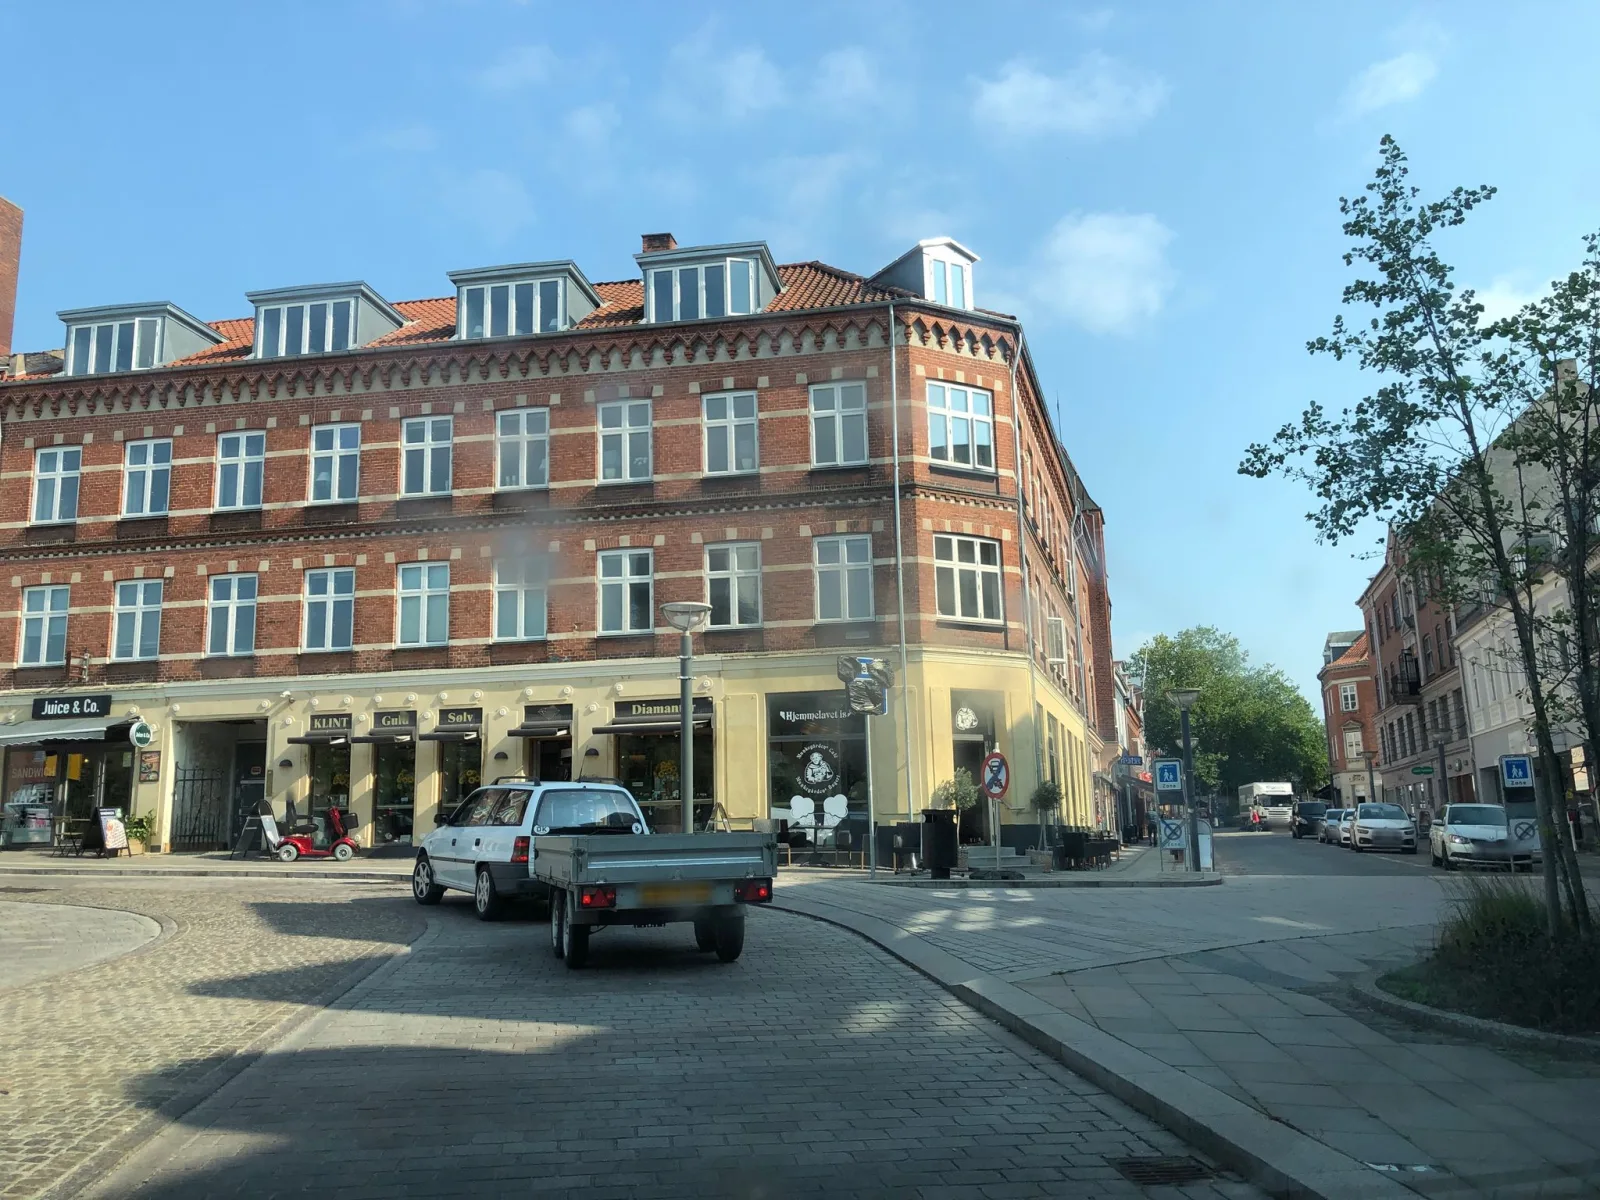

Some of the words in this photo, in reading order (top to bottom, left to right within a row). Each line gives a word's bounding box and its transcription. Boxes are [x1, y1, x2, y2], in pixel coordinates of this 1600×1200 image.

[41, 700, 70, 715] Juice
[72, 701, 81, 713] &
[83, 699, 100, 713] Co.
[632, 703, 697, 715] Diamanr
[447, 711, 474, 723] Sølv
[785, 710, 838, 722] Hjemmelavet
[313, 717, 349, 729] KLINT
